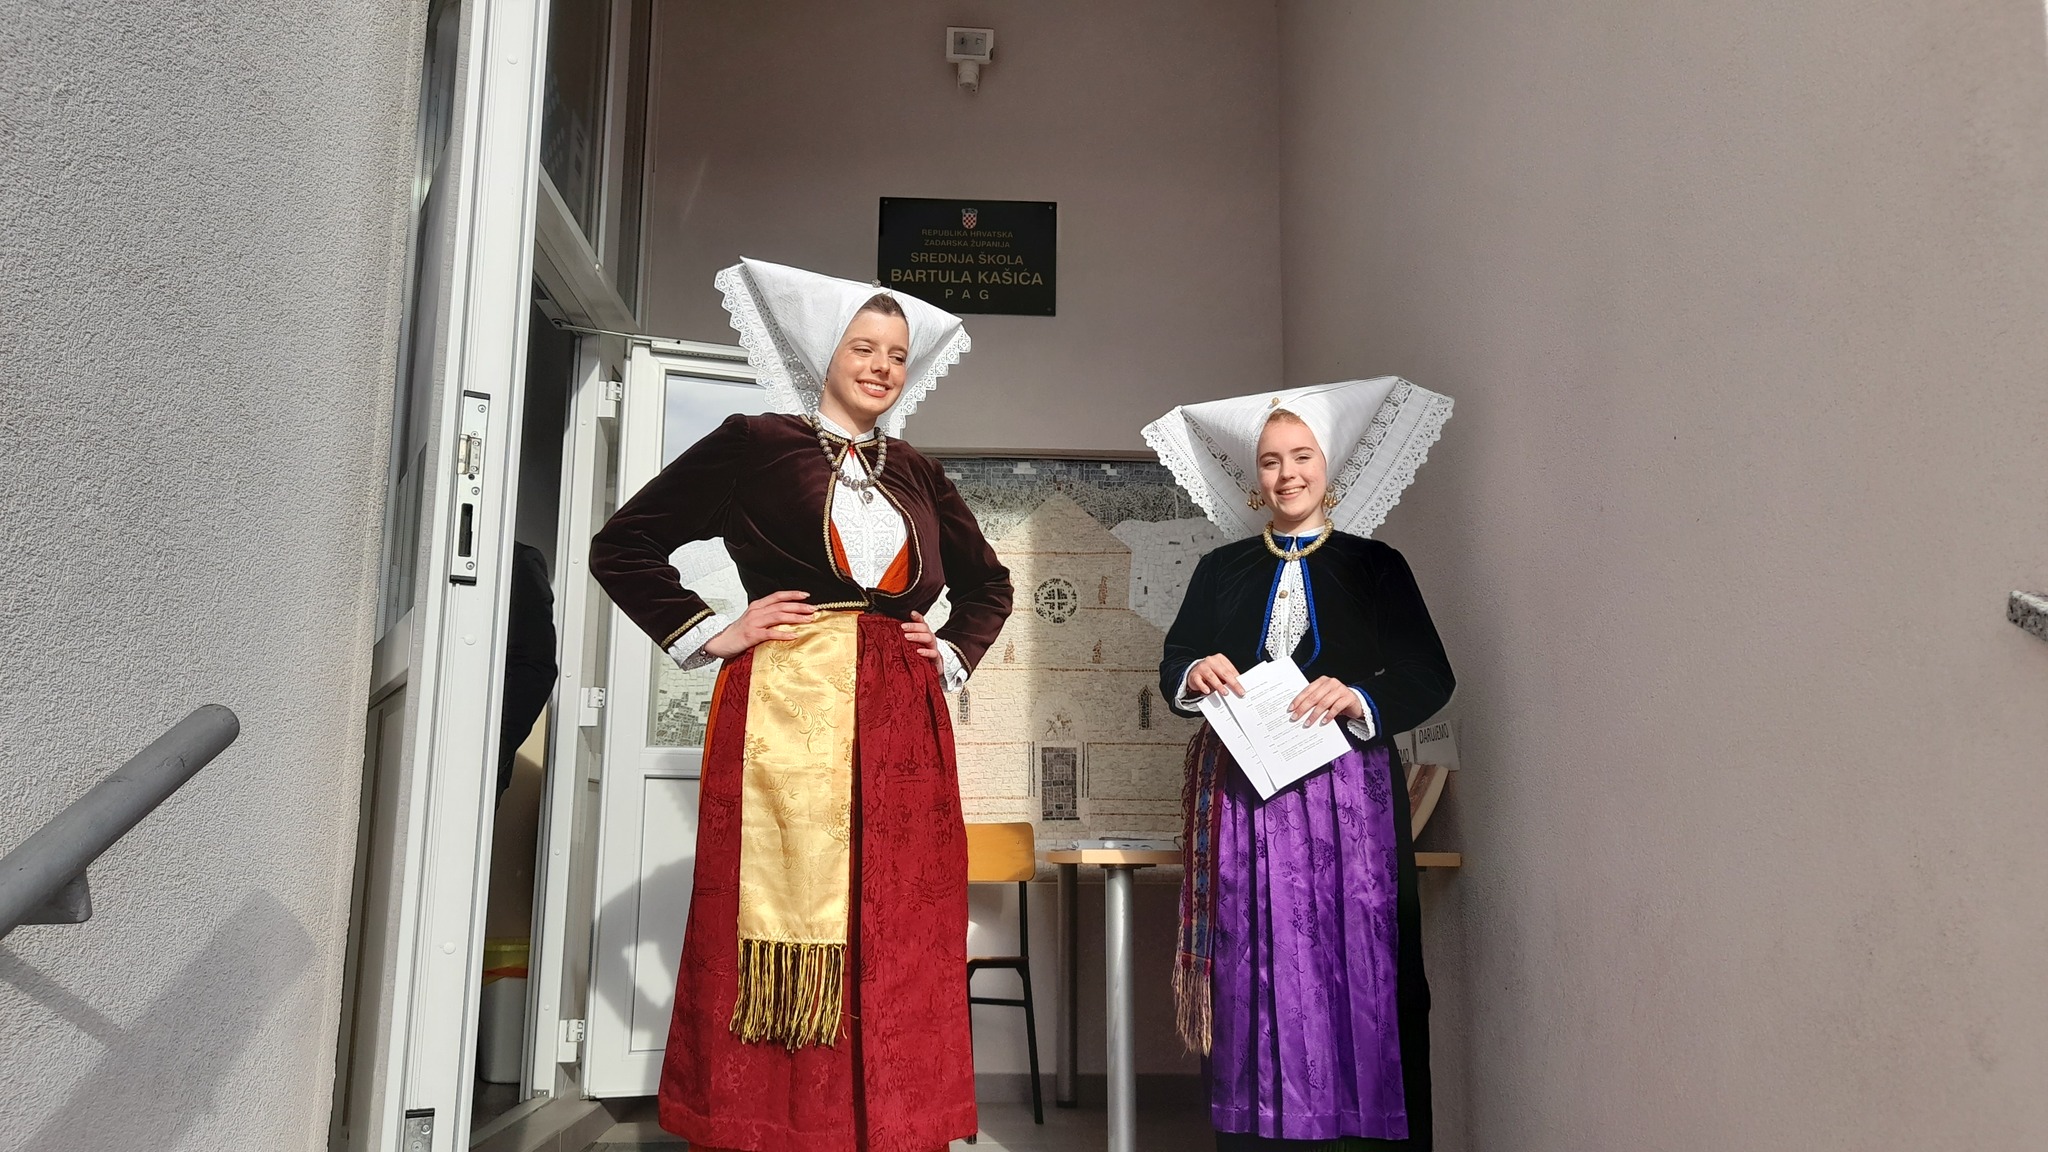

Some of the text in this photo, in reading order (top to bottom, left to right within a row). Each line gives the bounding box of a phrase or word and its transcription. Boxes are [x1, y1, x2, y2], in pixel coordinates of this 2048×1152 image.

[921, 229, 1013, 238] REPUBLIKA HRVATSKA
[924, 239, 1011, 248] ZADARSKA ŽUPANIJA
[910, 251, 1024, 265] SREDNJA ŠKOLA
[890, 267, 1043, 286] BARTULA KAŠIĆA
[1419, 723, 1449, 744] DARUJEMO
